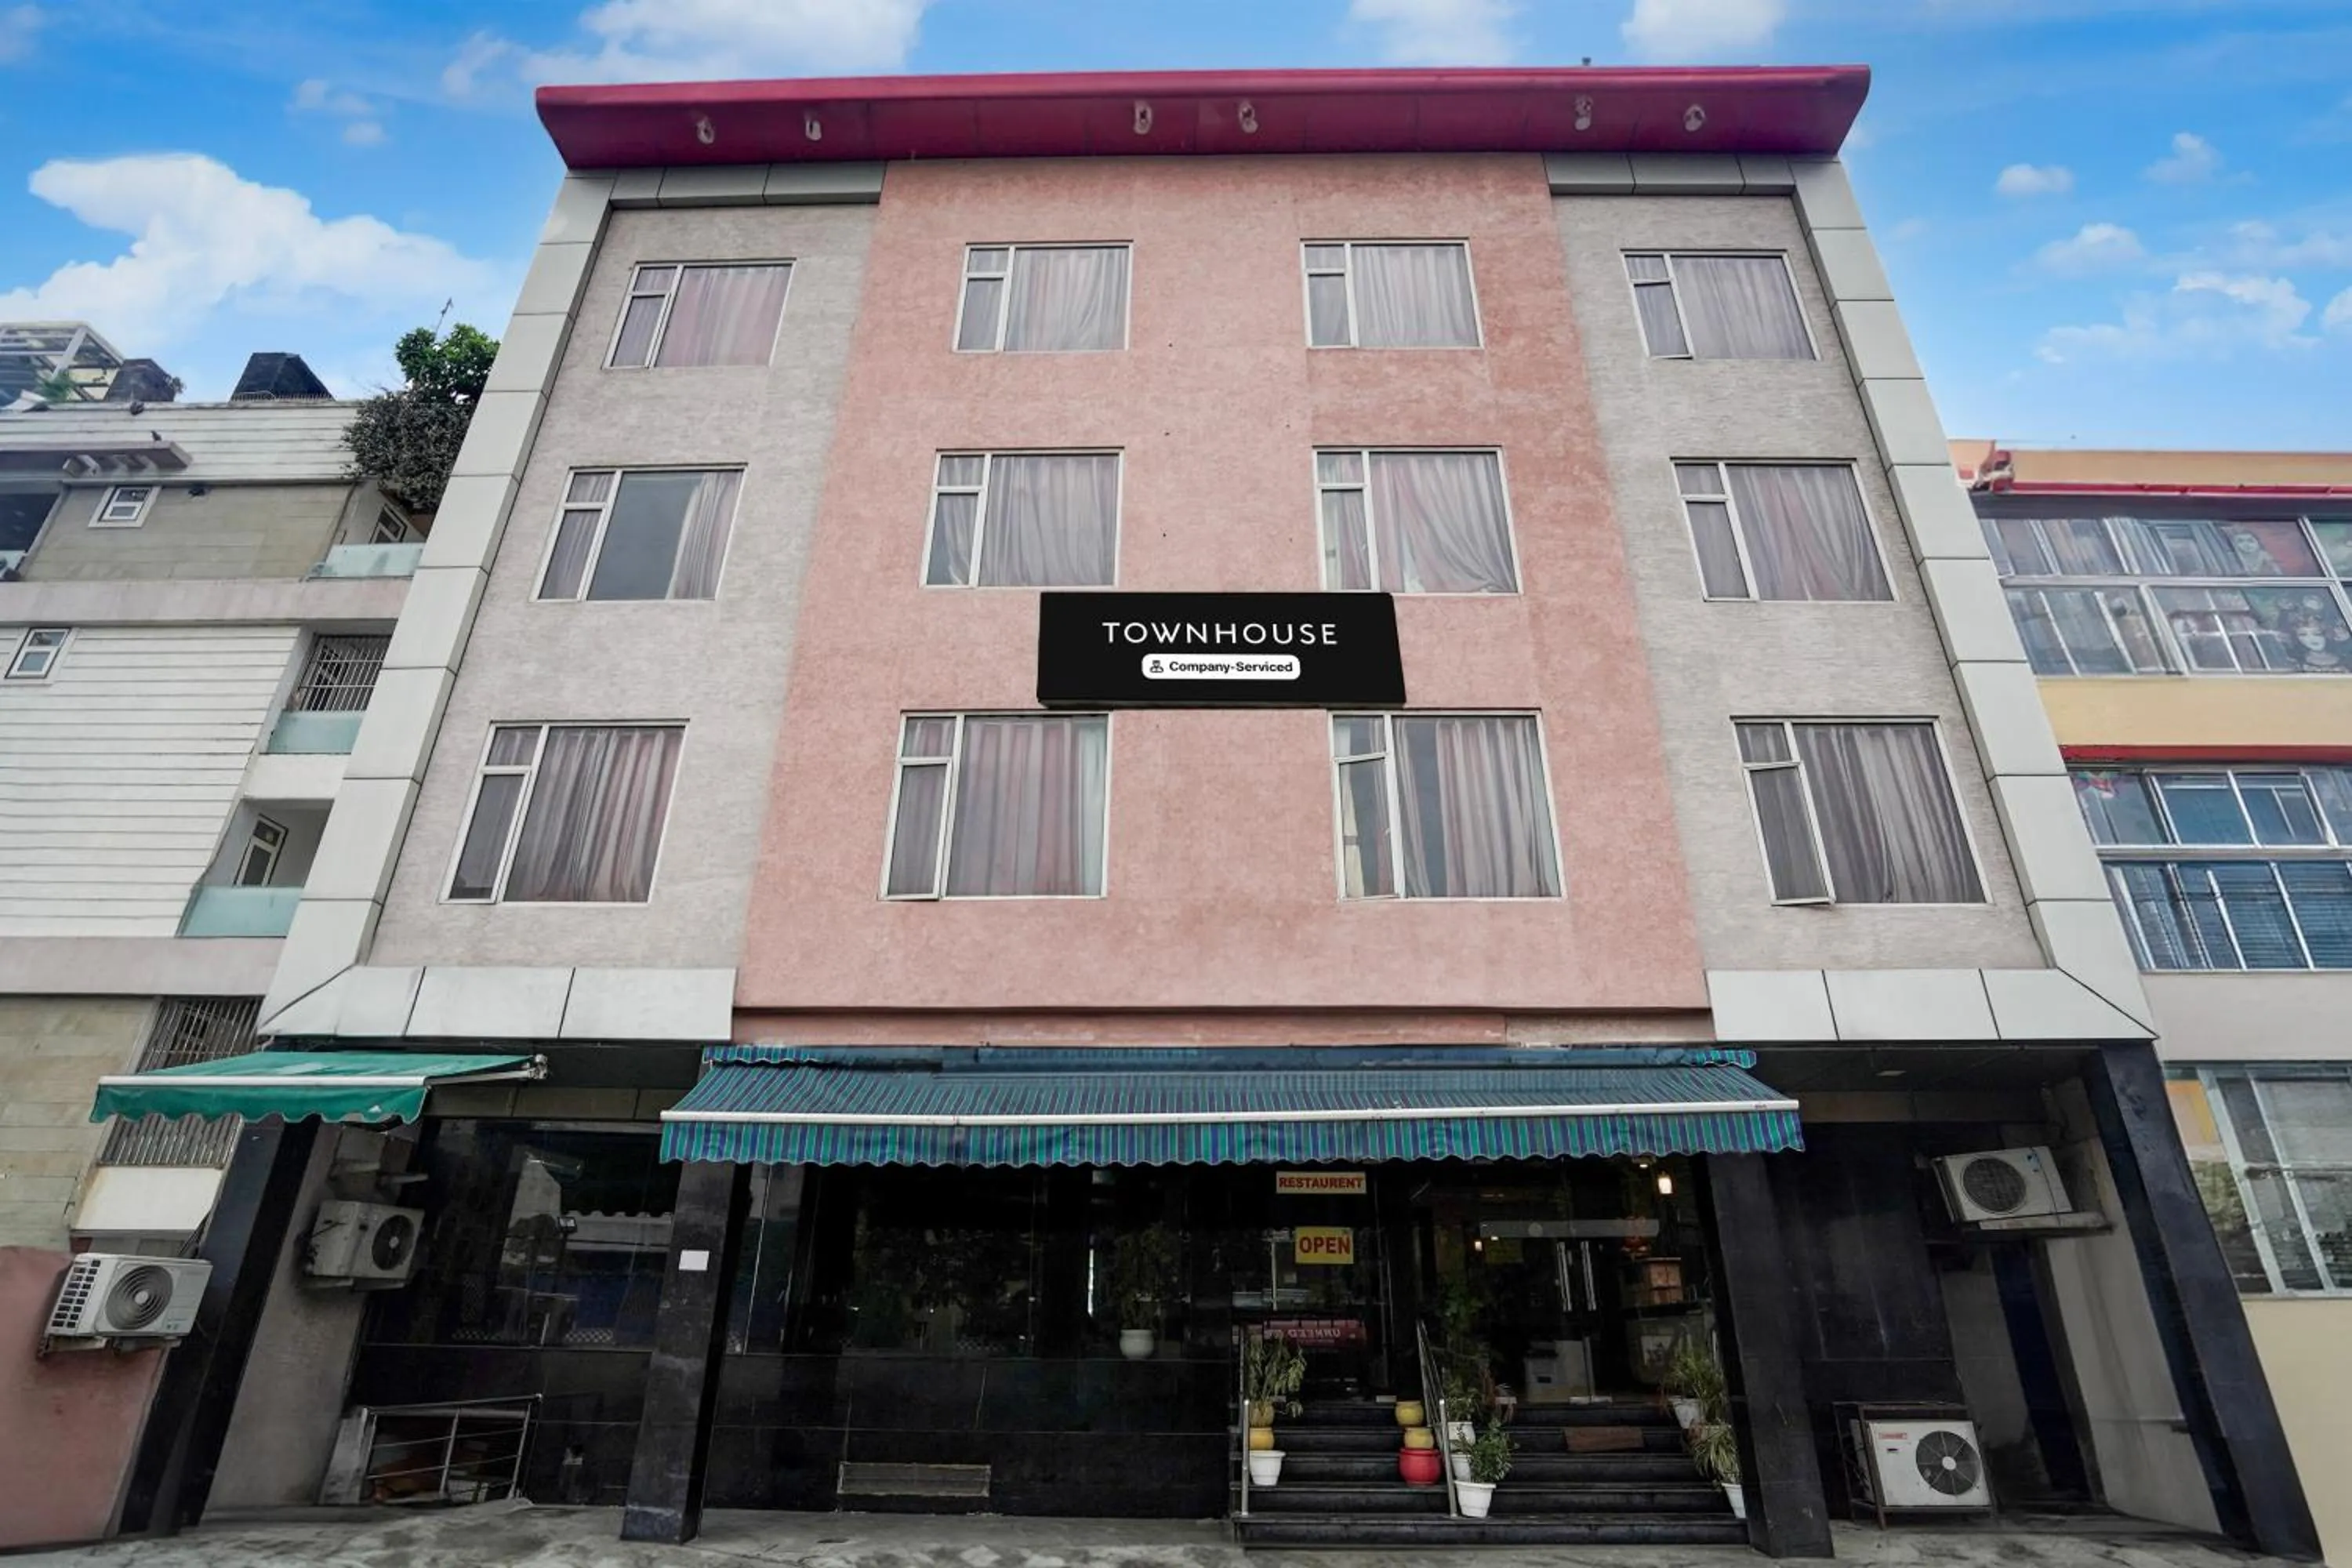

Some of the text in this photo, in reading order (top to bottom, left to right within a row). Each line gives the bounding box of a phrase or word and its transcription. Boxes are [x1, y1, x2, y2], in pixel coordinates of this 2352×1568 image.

[1102, 622, 1338, 644] TOWNHOUSE
[1169, 661, 1293, 674] Company-Serviced
[1279, 1178, 1363, 1189] RESTAURENT
[1299, 1236, 1351, 1254] OPEN
